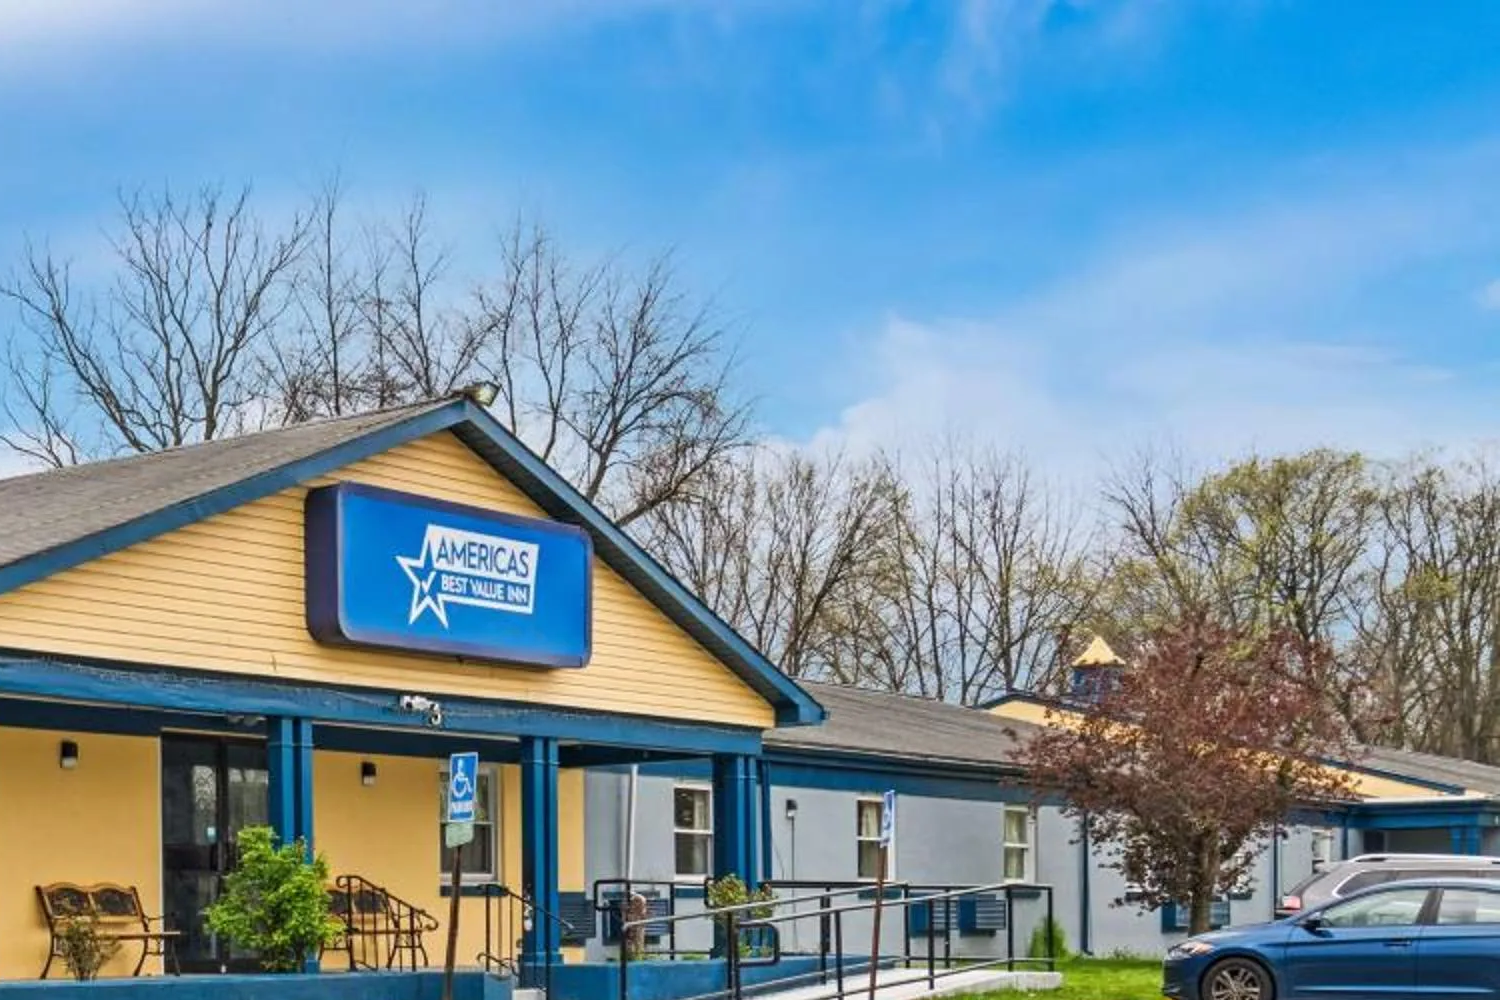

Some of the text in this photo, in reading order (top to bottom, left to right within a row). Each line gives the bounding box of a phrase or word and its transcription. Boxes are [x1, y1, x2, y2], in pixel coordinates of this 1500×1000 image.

[435, 536, 529, 579] AMERICAS
[441, 573, 528, 603] BEST VALUE INN
